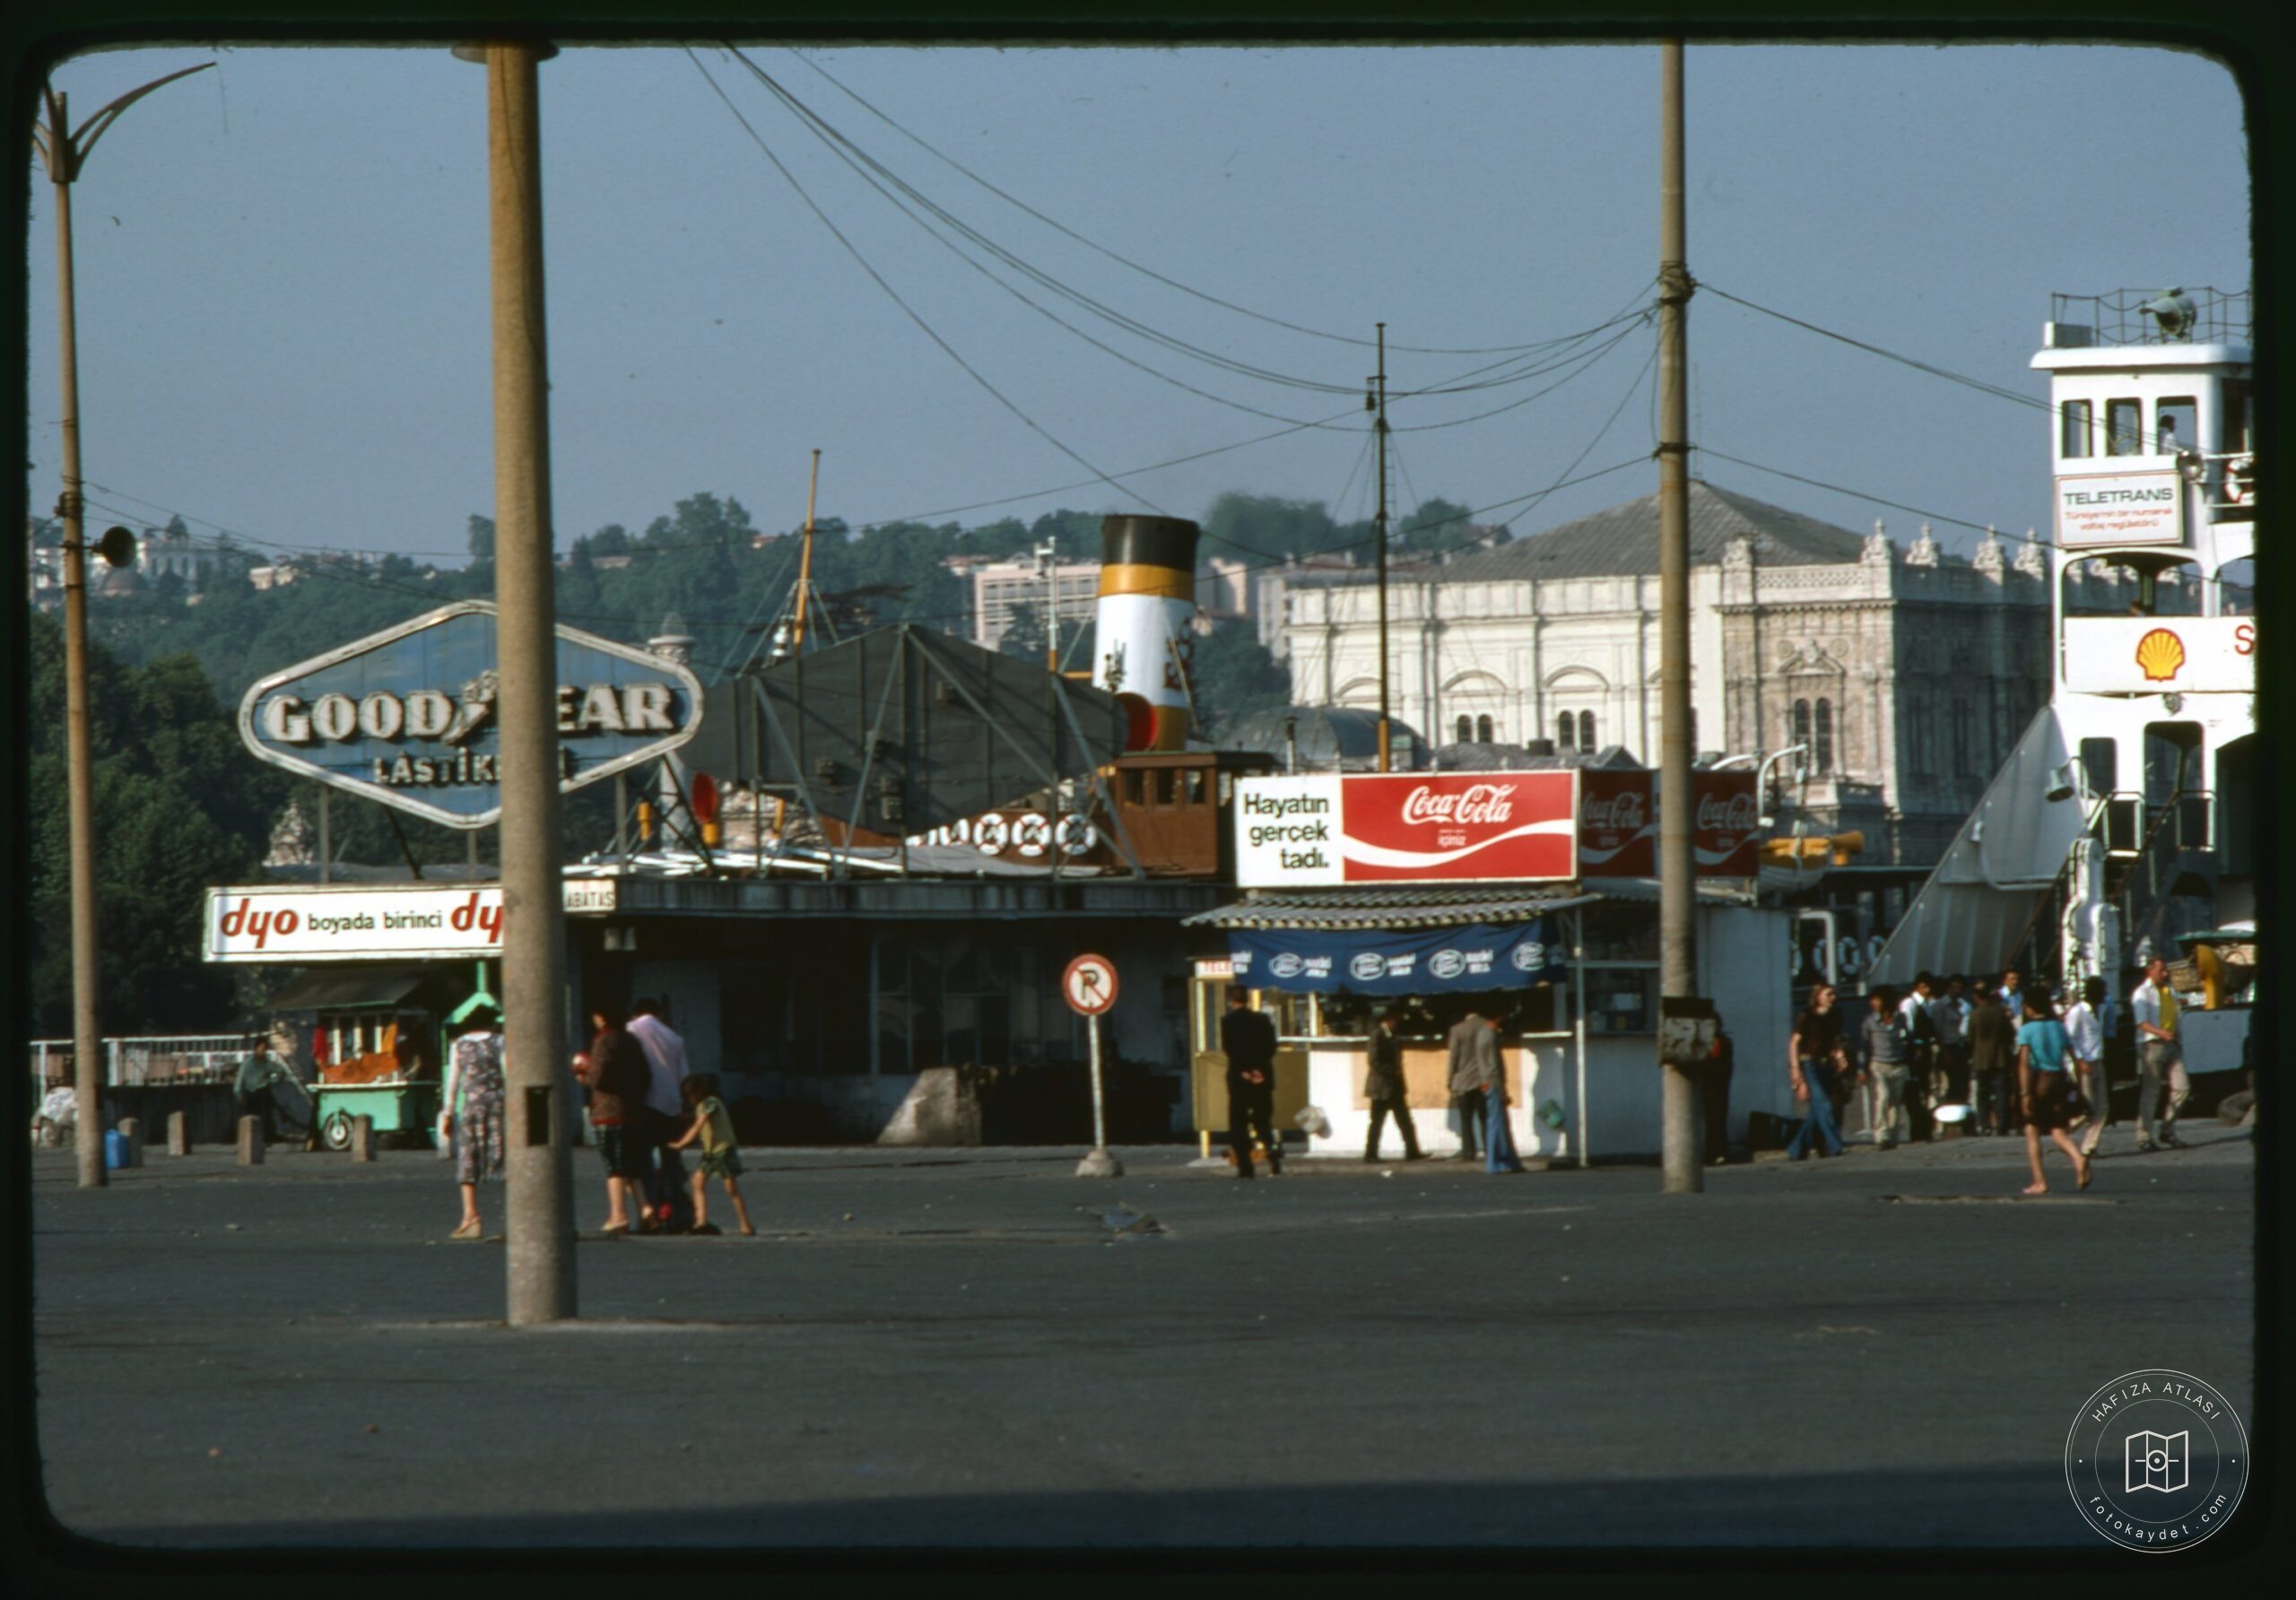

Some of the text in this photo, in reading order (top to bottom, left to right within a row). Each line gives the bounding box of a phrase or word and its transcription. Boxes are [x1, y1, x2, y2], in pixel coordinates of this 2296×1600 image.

[2064, 488, 2174, 505] TELETRANS
[264, 683, 674, 742] GOODEAR
[1244, 793, 1329, 818] Hayatın
[1402, 784, 1518, 824] Coca-Cola
[1280, 847, 1330, 869] tadı.
[221, 892, 504, 949] dyo boyada birinci dy
